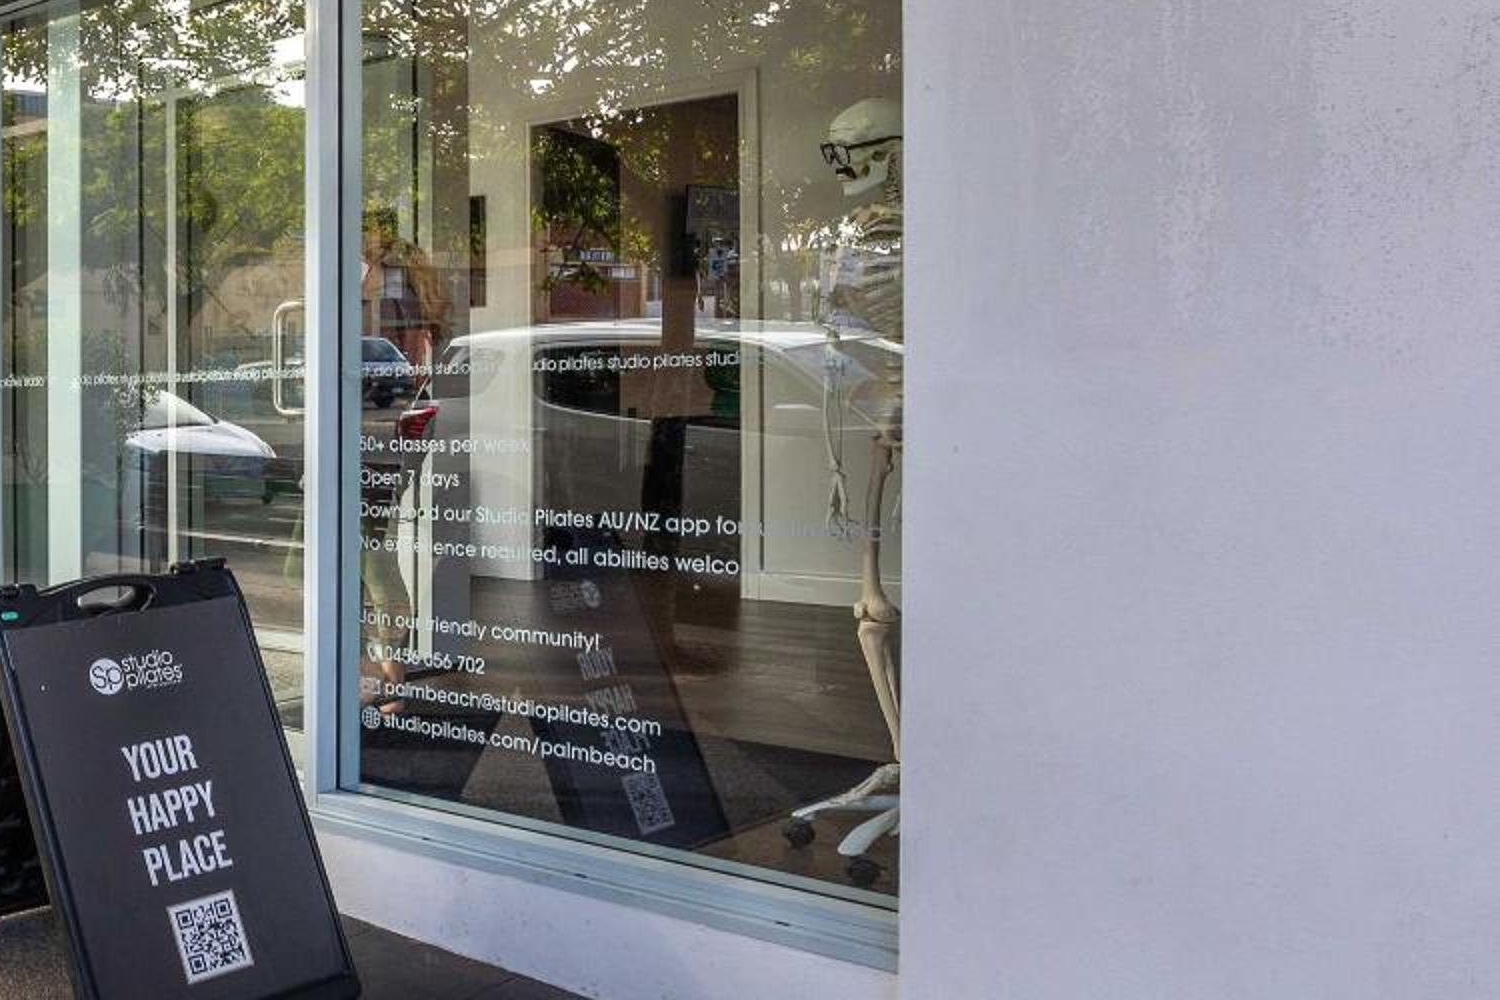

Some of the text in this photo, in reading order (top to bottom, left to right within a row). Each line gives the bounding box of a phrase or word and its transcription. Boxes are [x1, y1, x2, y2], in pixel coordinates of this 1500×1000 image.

[607, 354, 651, 371] studio
[653, 352, 703, 370] pilates
[389, 436, 447, 452] classes
[359, 469, 461, 490] Open 7 days
[359, 502, 440, 522] Downoad
[443, 507, 474, 523] our
[534, 507, 594, 530] Pilates
[598, 511, 661, 532] AU/NZ
[665, 515, 711, 537] app
[384, 536, 477, 558] exeence
[481, 544, 561, 566] requied,
[565, 548, 589, 566] all
[593, 549, 669, 571] abilities
[359, 608, 391, 627] Join
[422, 614, 487, 641] iendly
[491, 625, 600, 652] community!
[121, 648, 174, 673] studio
[126, 664, 183, 692] pilates
[457, 656, 486, 675] 702
[384, 680, 662, 737] palmbeach@studiopilates.com
[121, 734, 199, 782] YOUR
[383, 712, 656, 774] studiopilates.com/palmbeach
[127, 780, 215, 835] HAPPY
[143, 829, 233, 887] PLACE
